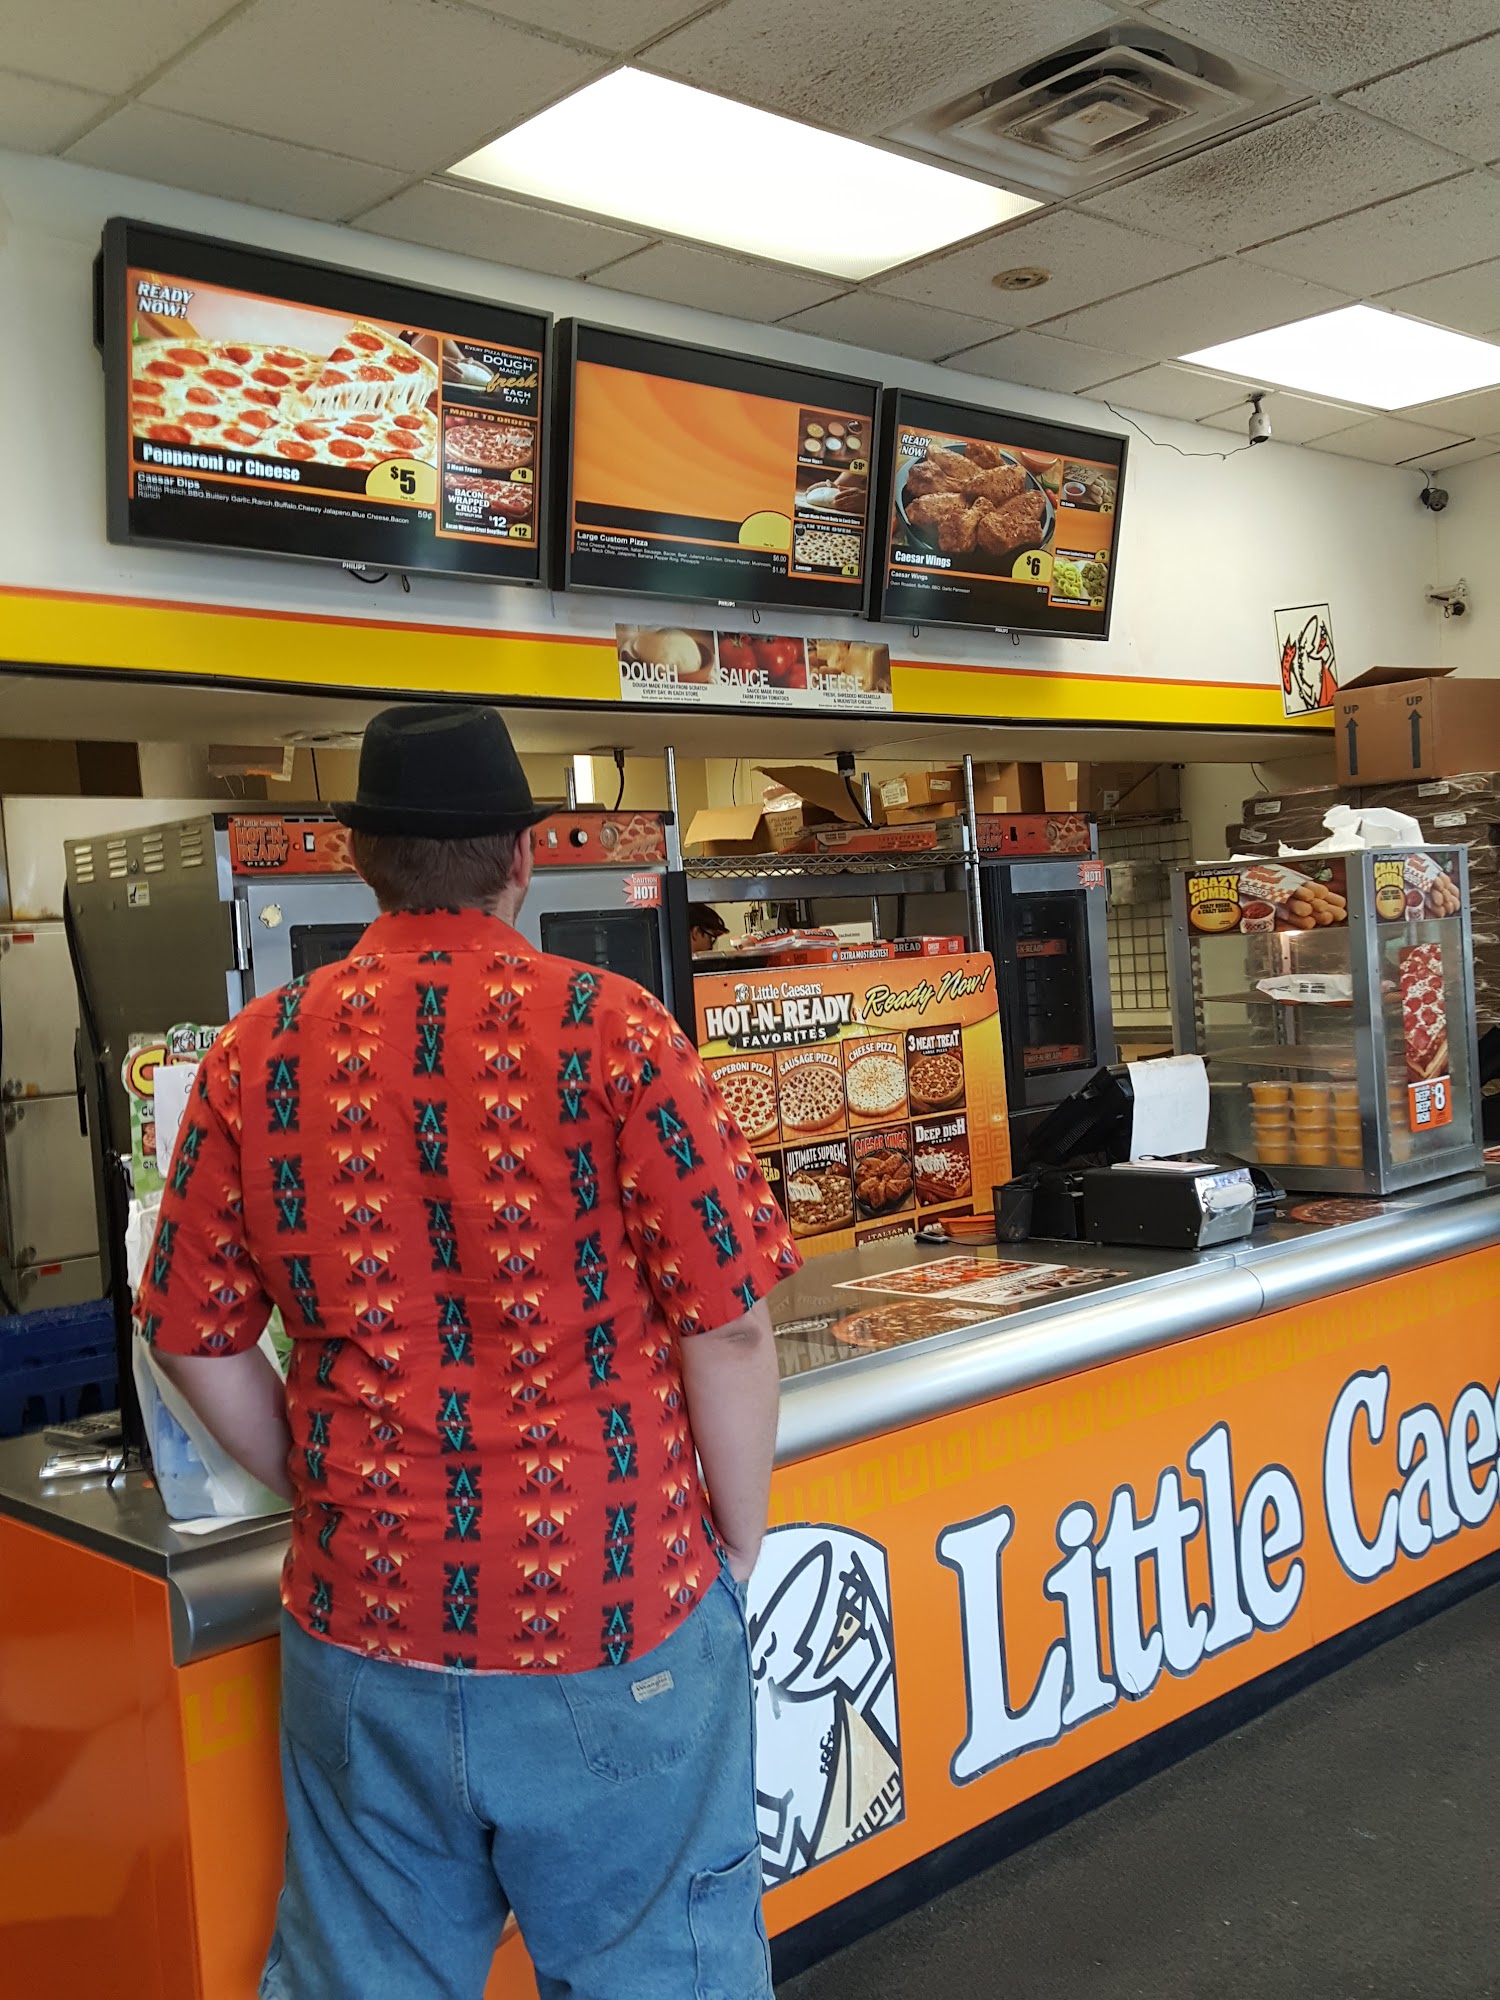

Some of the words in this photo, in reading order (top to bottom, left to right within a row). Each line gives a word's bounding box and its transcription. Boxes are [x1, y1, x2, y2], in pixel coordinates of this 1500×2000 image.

[138, 280, 194, 304] READY
[138, 298, 187, 319] NOW!
[483, 354, 533, 371] DOUGH
[486, 372, 538, 392] fresh
[504, 388, 531, 398] EACH
[506, 396, 528, 405] DAY!
[450, 408, 479, 418] MADE
[497, 416, 530, 427] ORDER
[902, 434, 931, 447] READY
[901, 445, 927, 458] NOW!
[143, 444, 223, 472] Pepperoni
[226, 459, 243, 474] or
[245, 460, 300, 481] Cheese
[138, 472, 174, 485] Caesar
[177, 478, 200, 489] Dips
[390, 466, 416, 494] $5
[448, 495, 490, 507] WRAPPED
[455, 489, 484, 498] BACON
[456, 504, 483, 514] CRUST
[578, 532, 598, 540] Large
[600, 534, 628, 544] Custom
[630, 538, 648, 546] Pizza
[342, 562, 366, 570] PHILIPS
[895, 551, 924, 564] Caesar
[926, 554, 951, 568] Wings
[1026, 556, 1040, 576] $6
[911, 573, 928, 581] Wings
[619, 661, 678, 682] DOUGH
[720, 668, 770, 688] SAUCE
[810, 673, 864, 692] CHEESE
[1344, 704, 1360, 715] UP
[1406, 696, 1423, 706] UP
[236, 827, 288, 844] HOT-N-
[238, 843, 289, 862] READY
[1374, 862, 1404, 879] CRAZY
[1189, 875, 1239, 894] CRAZY
[1376, 872, 1404, 891] COMBO
[634, 886, 658, 900] HOT!
[1191, 887, 1238, 906] COMBO
[894, 942, 922, 952] BREAD
[750, 985, 779, 1000] Little
[781, 983, 823, 998] Caesars
[863, 980, 934, 1020] Ready
[936, 966, 991, 1002] Now!
[705, 994, 852, 1038] HOT-N-READY
[742, 1028, 827, 1048] FAVORITES
[908, 1036, 916, 1052] 3
[916, 1036, 936, 1050] MEAT
[936, 1031, 960, 1047] TREAT
[848, 1044, 874, 1063] CHEESE
[875, 1042, 897, 1054] PIZZA
[712, 1062, 750, 1080] EPPERONI
[751, 1064, 773, 1078] PIZZA
[780, 1053, 814, 1075] SAUSAGE
[816, 1053, 838, 1067] PIZZA
[1431, 1082, 1446, 1110] $8
[916, 1124, 942, 1143] DEEP
[943, 1117, 966, 1136] DISH
[854, 1135, 884, 1158] CAESAR
[885, 1131, 908, 1150] WINGS
[786, 1148, 818, 1176] ULTIMATE
[818, 1142, 847, 1166] SUPREME
[804, 1161, 832, 1170] PIZZA
[868, 1227, 903, 1240] ITALIAN
[936, 1419, 1304, 1788] Little
[1322, 1366, 1500, 1586] Cae
[636, 1678, 667, 1691] Wrangler
